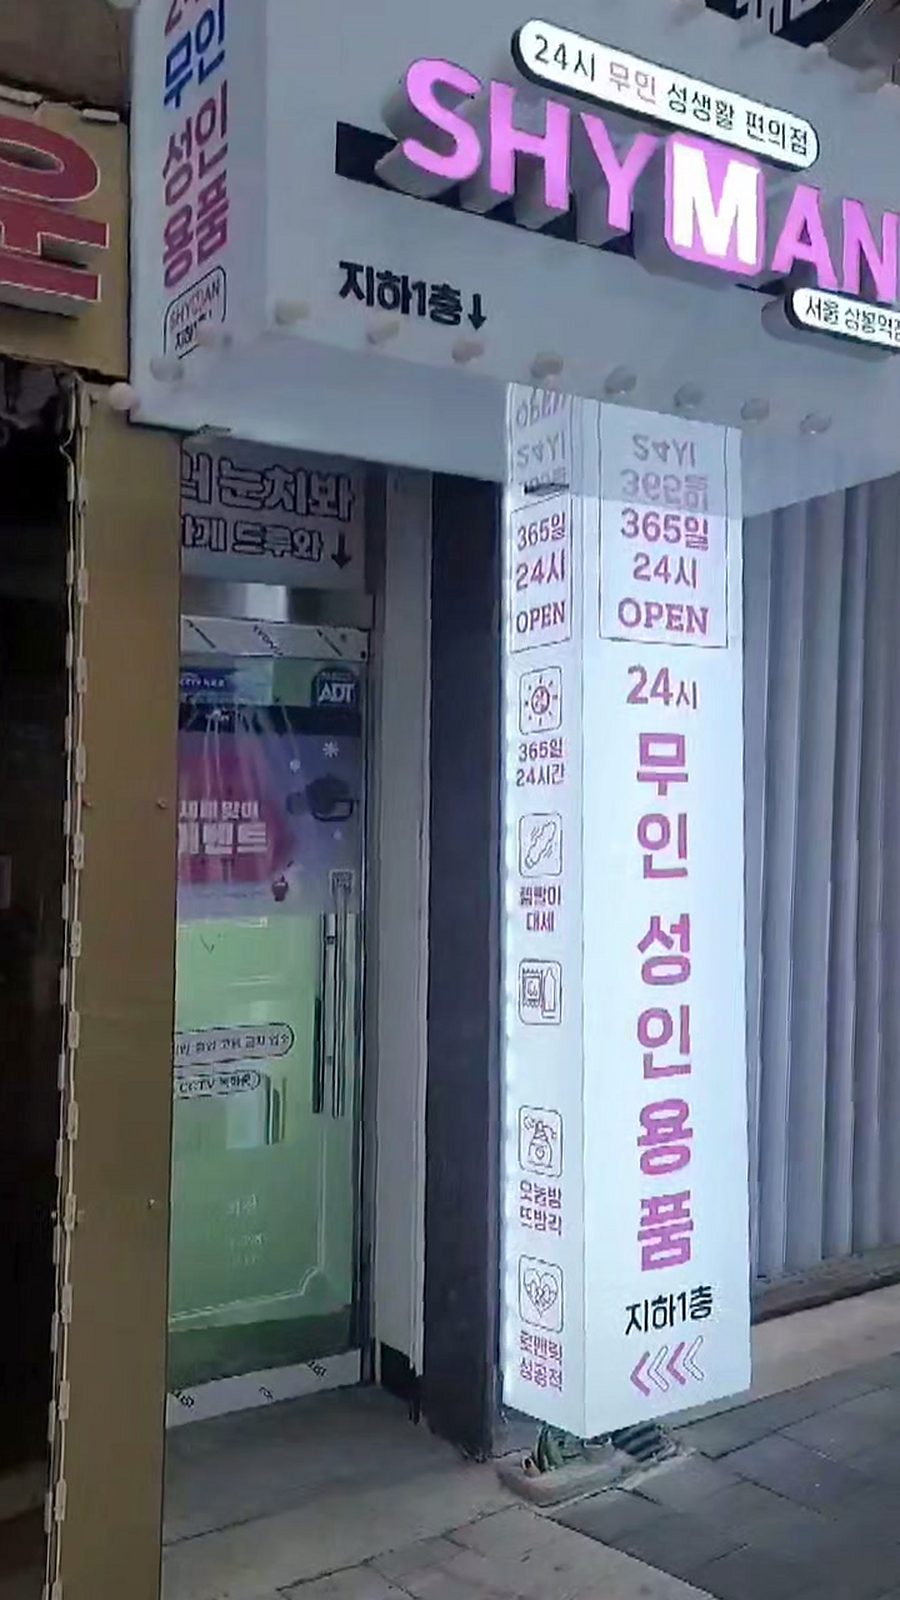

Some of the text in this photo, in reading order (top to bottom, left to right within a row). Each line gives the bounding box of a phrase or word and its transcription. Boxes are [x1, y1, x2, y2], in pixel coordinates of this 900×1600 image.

[164, 0, 225, 109] 무인
[534, 33, 809, 156] 24시 무인 성생활 편의점
[163, 80, 228, 206] 성인
[403, 58, 899, 302] SHYMAN
[163, 170, 228, 288] 용품
[339, 260, 463, 326] 지하1층
[806, 295, 839, 326] 서울
[517, 512, 566, 551] 365일
[620, 507, 709, 552] 365일
[516, 549, 566, 592] 24시
[632, 552, 698, 589] 24시
[516, 601, 566, 635] OPEN
[617, 597, 710, 636] OPEN
[319, 682, 356, 704] ADT
[626, 663, 698, 710] 24시
[518, 738, 563, 763] 365일
[516, 763, 565, 788] 24시간
[636, 732, 689, 880] 무인
[179, 1078, 215, 1094] CCTV
[519, 1180, 562, 1210] 오늘밤
[625, 1285, 713, 1335] 지하1층
